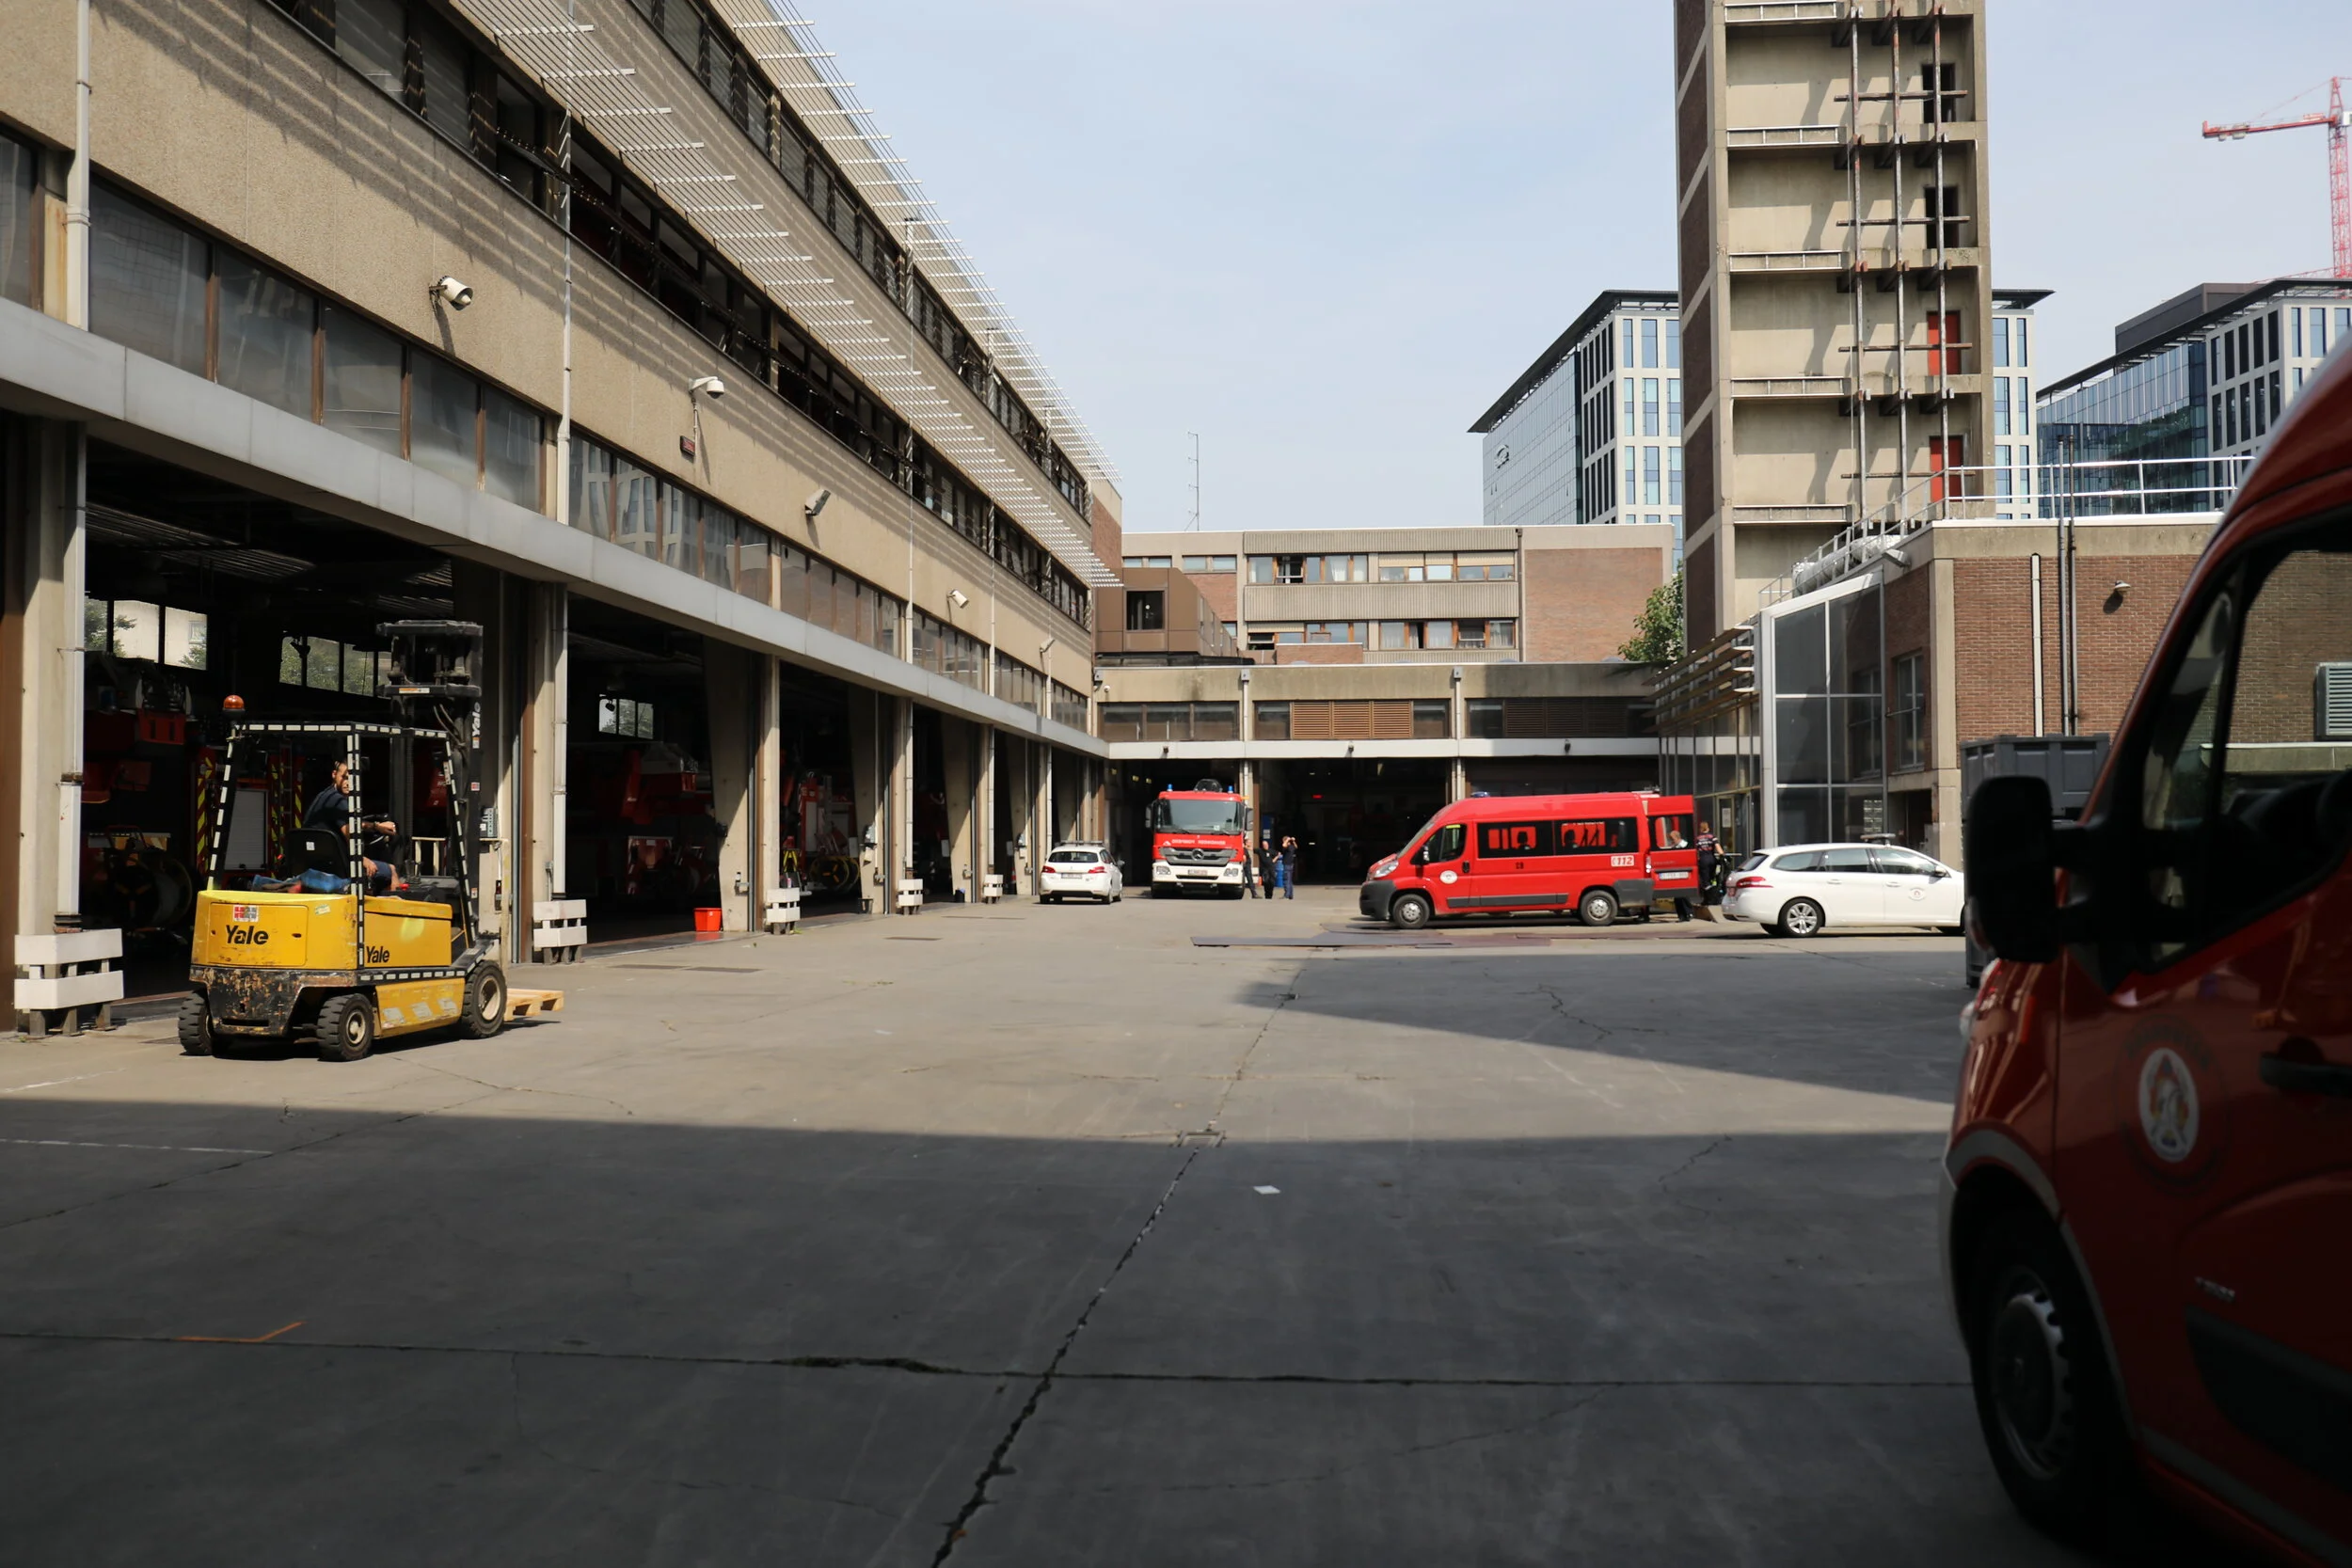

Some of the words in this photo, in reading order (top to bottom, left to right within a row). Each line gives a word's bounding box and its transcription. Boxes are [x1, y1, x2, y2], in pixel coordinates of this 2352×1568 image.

[1617, 857, 1632, 865] 112
[226, 925, 269, 945] Yale
[366, 945, 390, 963] Yale
